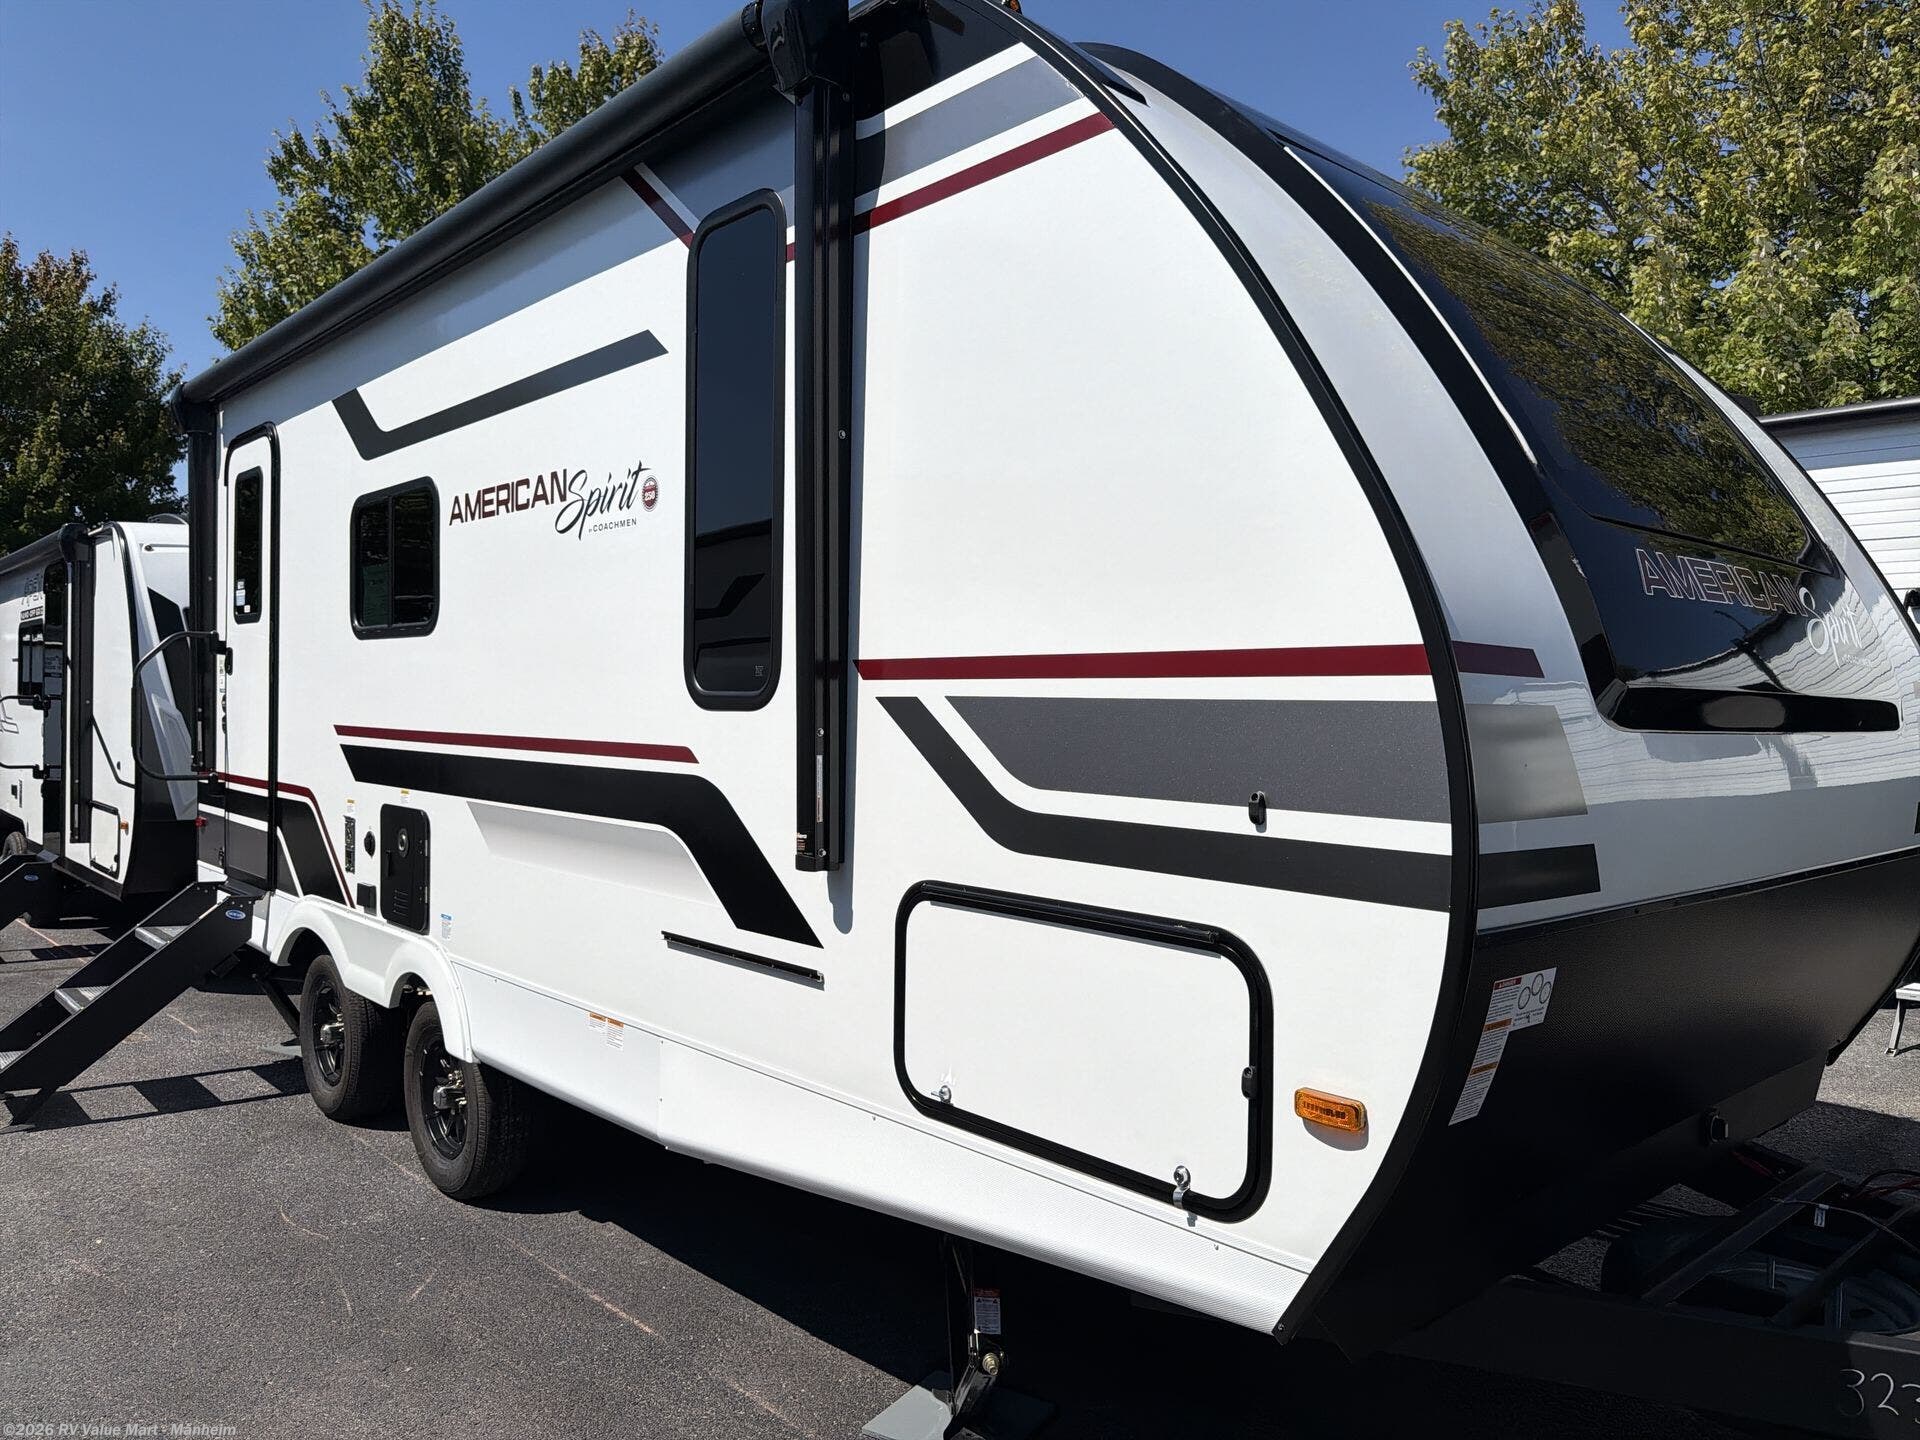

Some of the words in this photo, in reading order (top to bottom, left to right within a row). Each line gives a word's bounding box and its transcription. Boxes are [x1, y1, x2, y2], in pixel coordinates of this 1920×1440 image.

[449, 468, 567, 526] AMERICAN
[554, 459, 651, 541] Spirit
[593, 517, 637, 532] COACHMEN
[1636, 548, 1808, 617] AMERICAN
[1799, 586, 1863, 669] Spirit
